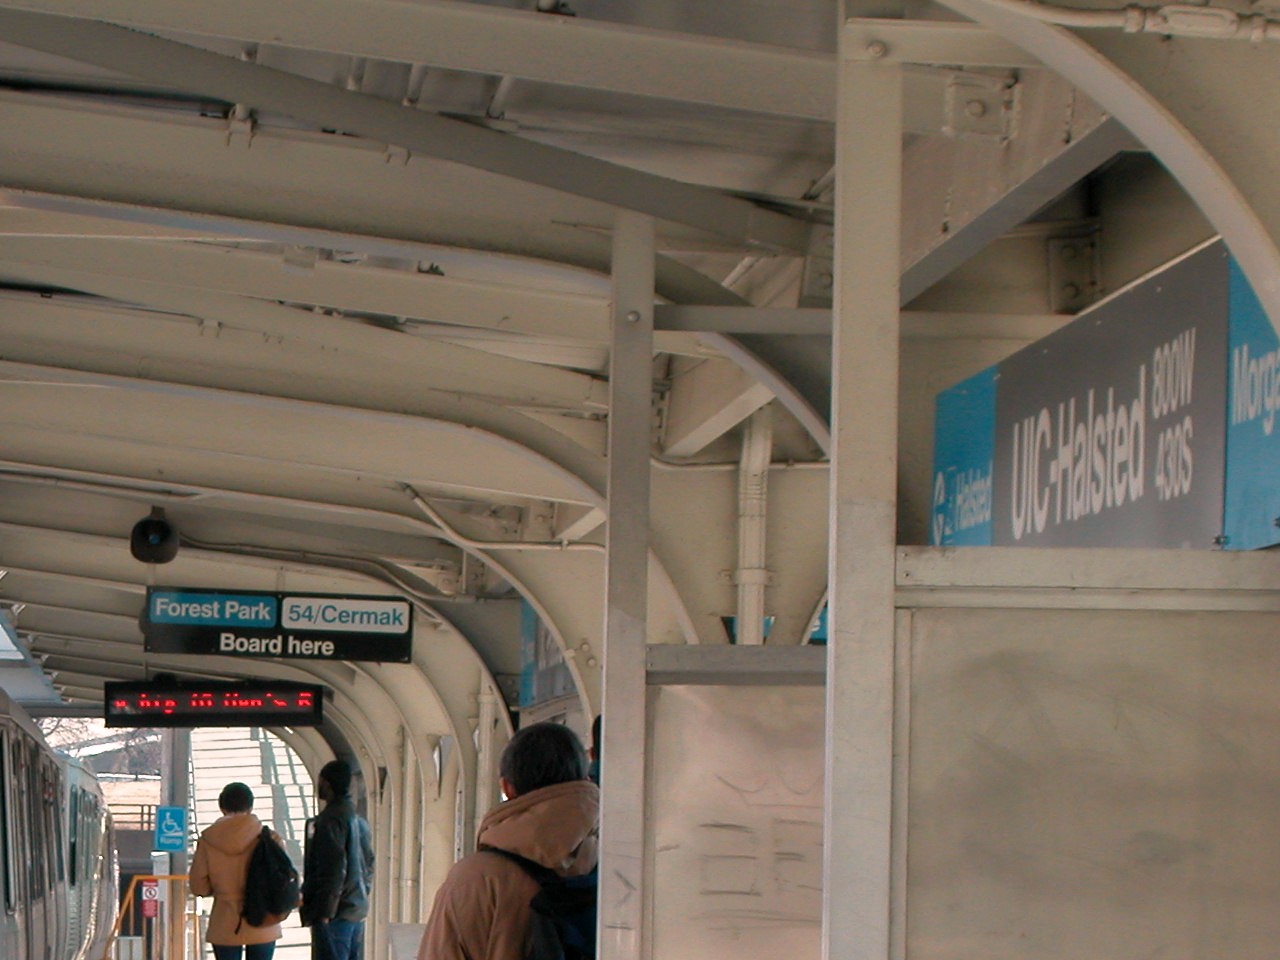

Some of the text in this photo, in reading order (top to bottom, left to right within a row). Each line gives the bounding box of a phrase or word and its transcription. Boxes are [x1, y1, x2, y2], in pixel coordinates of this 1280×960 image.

[1152, 327, 1196, 419] 800W
[1011, 364, 1147, 540] UIC-Halsted
[1155, 415, 1194, 500] 430S
[155, 598, 271, 620] Forest Park
[288, 604, 404, 626] 54/Cermak
[220, 633, 335, 656] Board here
